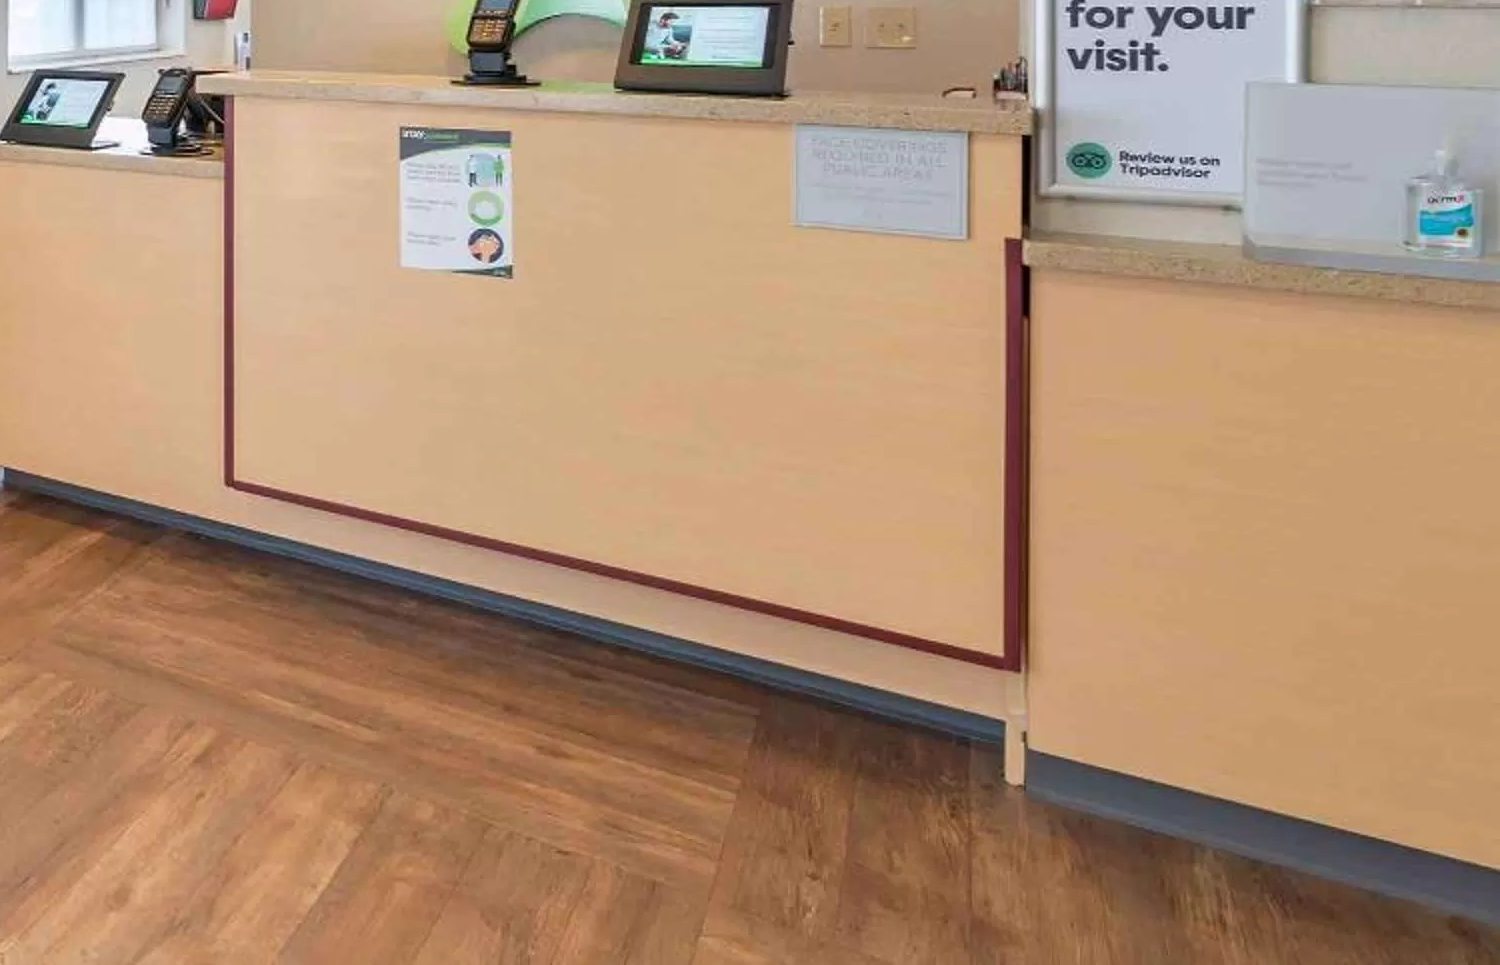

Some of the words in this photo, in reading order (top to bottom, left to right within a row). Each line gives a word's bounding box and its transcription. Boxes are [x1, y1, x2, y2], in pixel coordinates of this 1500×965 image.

[1146, 5, 1256, 36] your
[1067, 40, 1169, 73] visit.
[1118, 150, 1174, 164] Review
[1179, 155, 1197, 165] us
[1200, 156, 1221, 166] on
[1119, 162, 1211, 178] Tripadvisor
